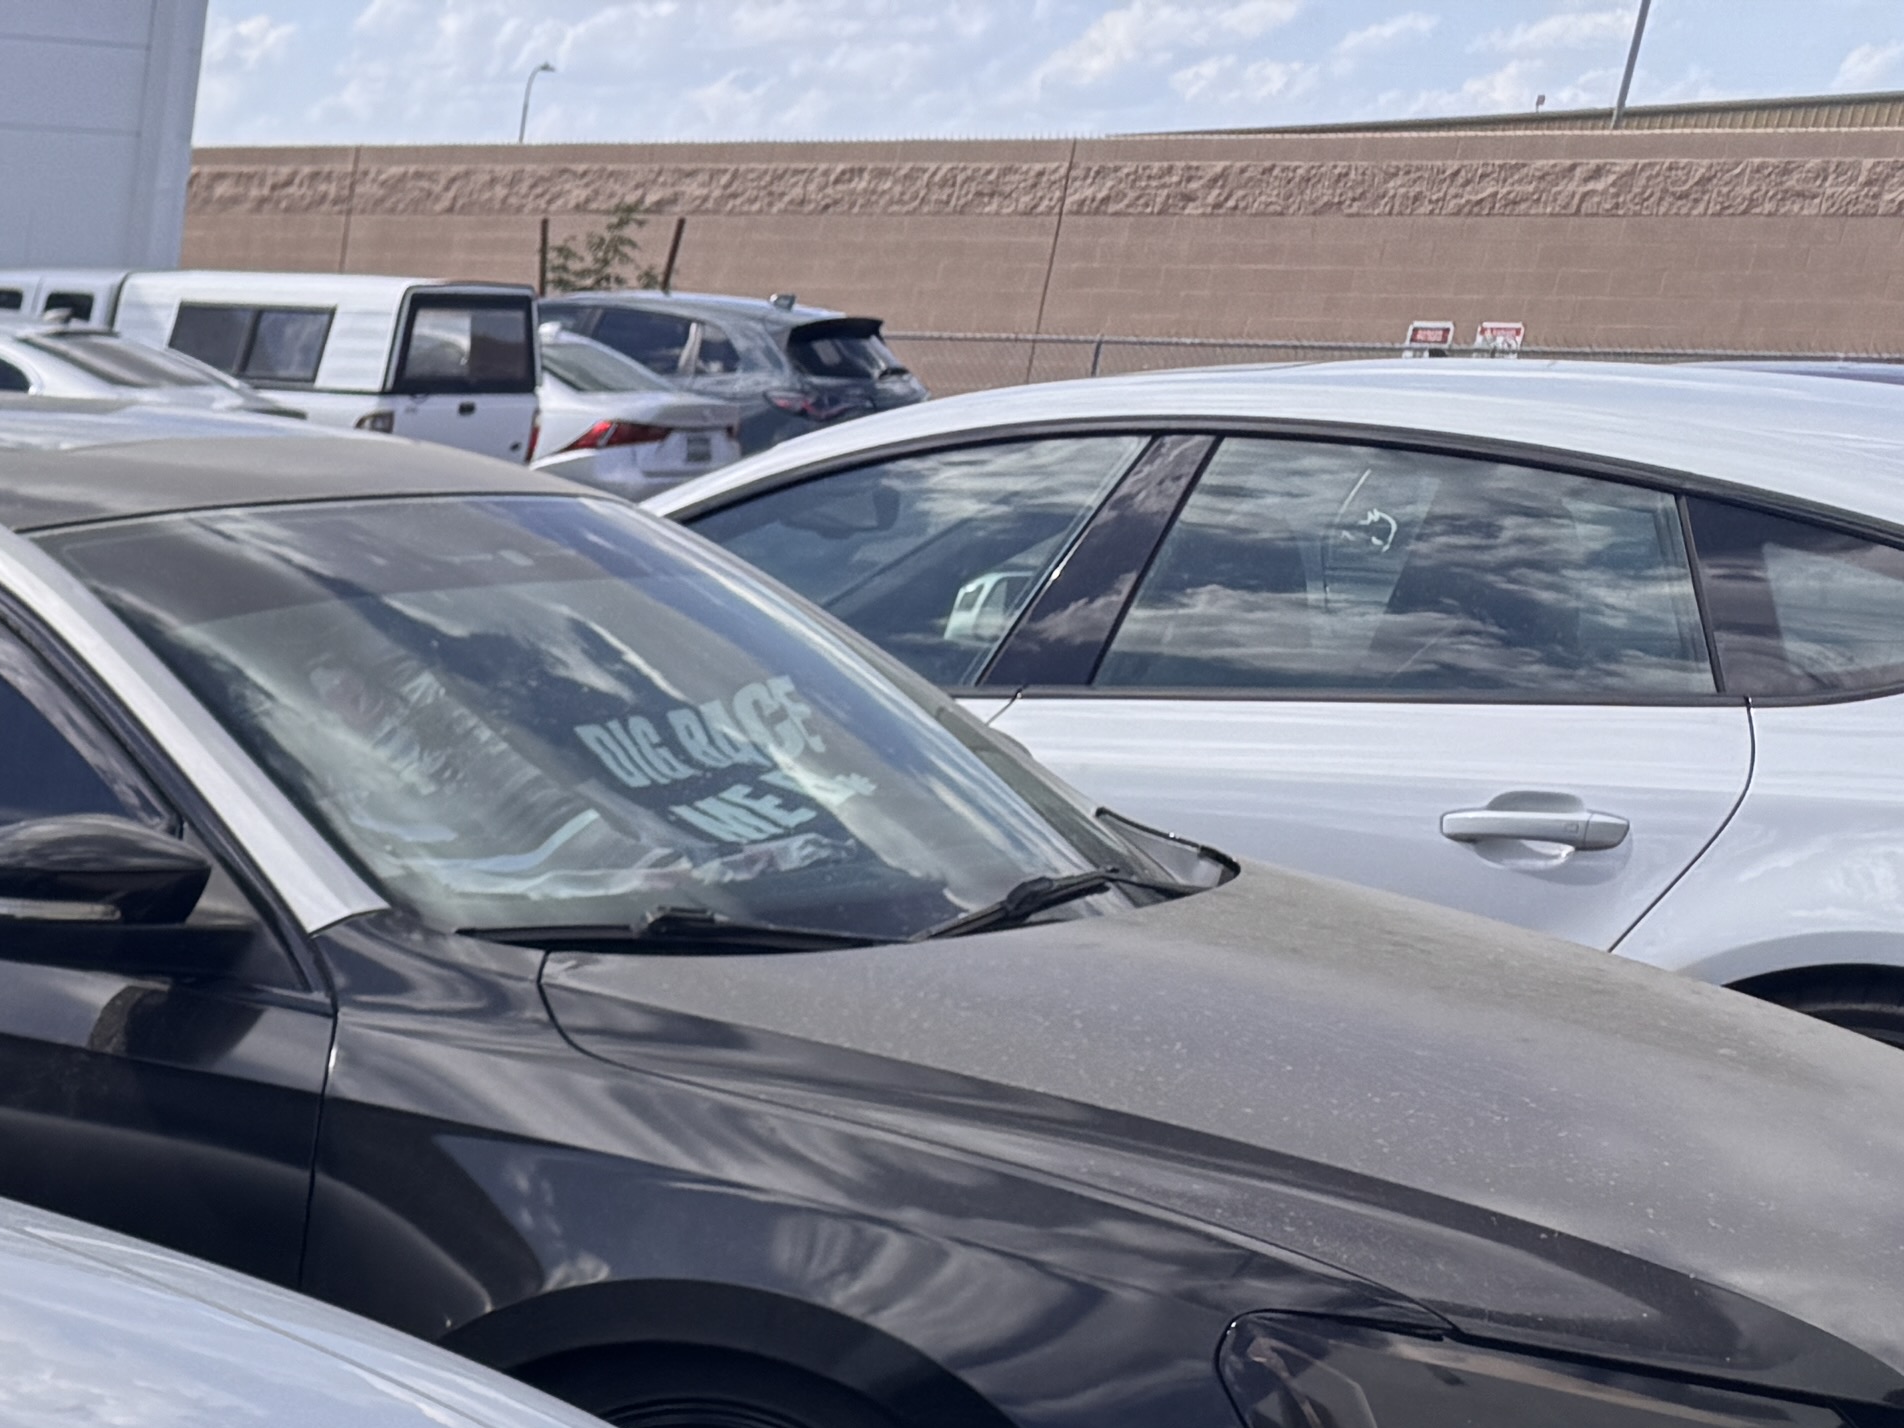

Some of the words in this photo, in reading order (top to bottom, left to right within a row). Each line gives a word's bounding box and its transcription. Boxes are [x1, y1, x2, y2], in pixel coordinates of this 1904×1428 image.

[573, 714, 702, 788] DIG
[667, 675, 826, 769] RACE
[668, 784, 817, 843] ME
